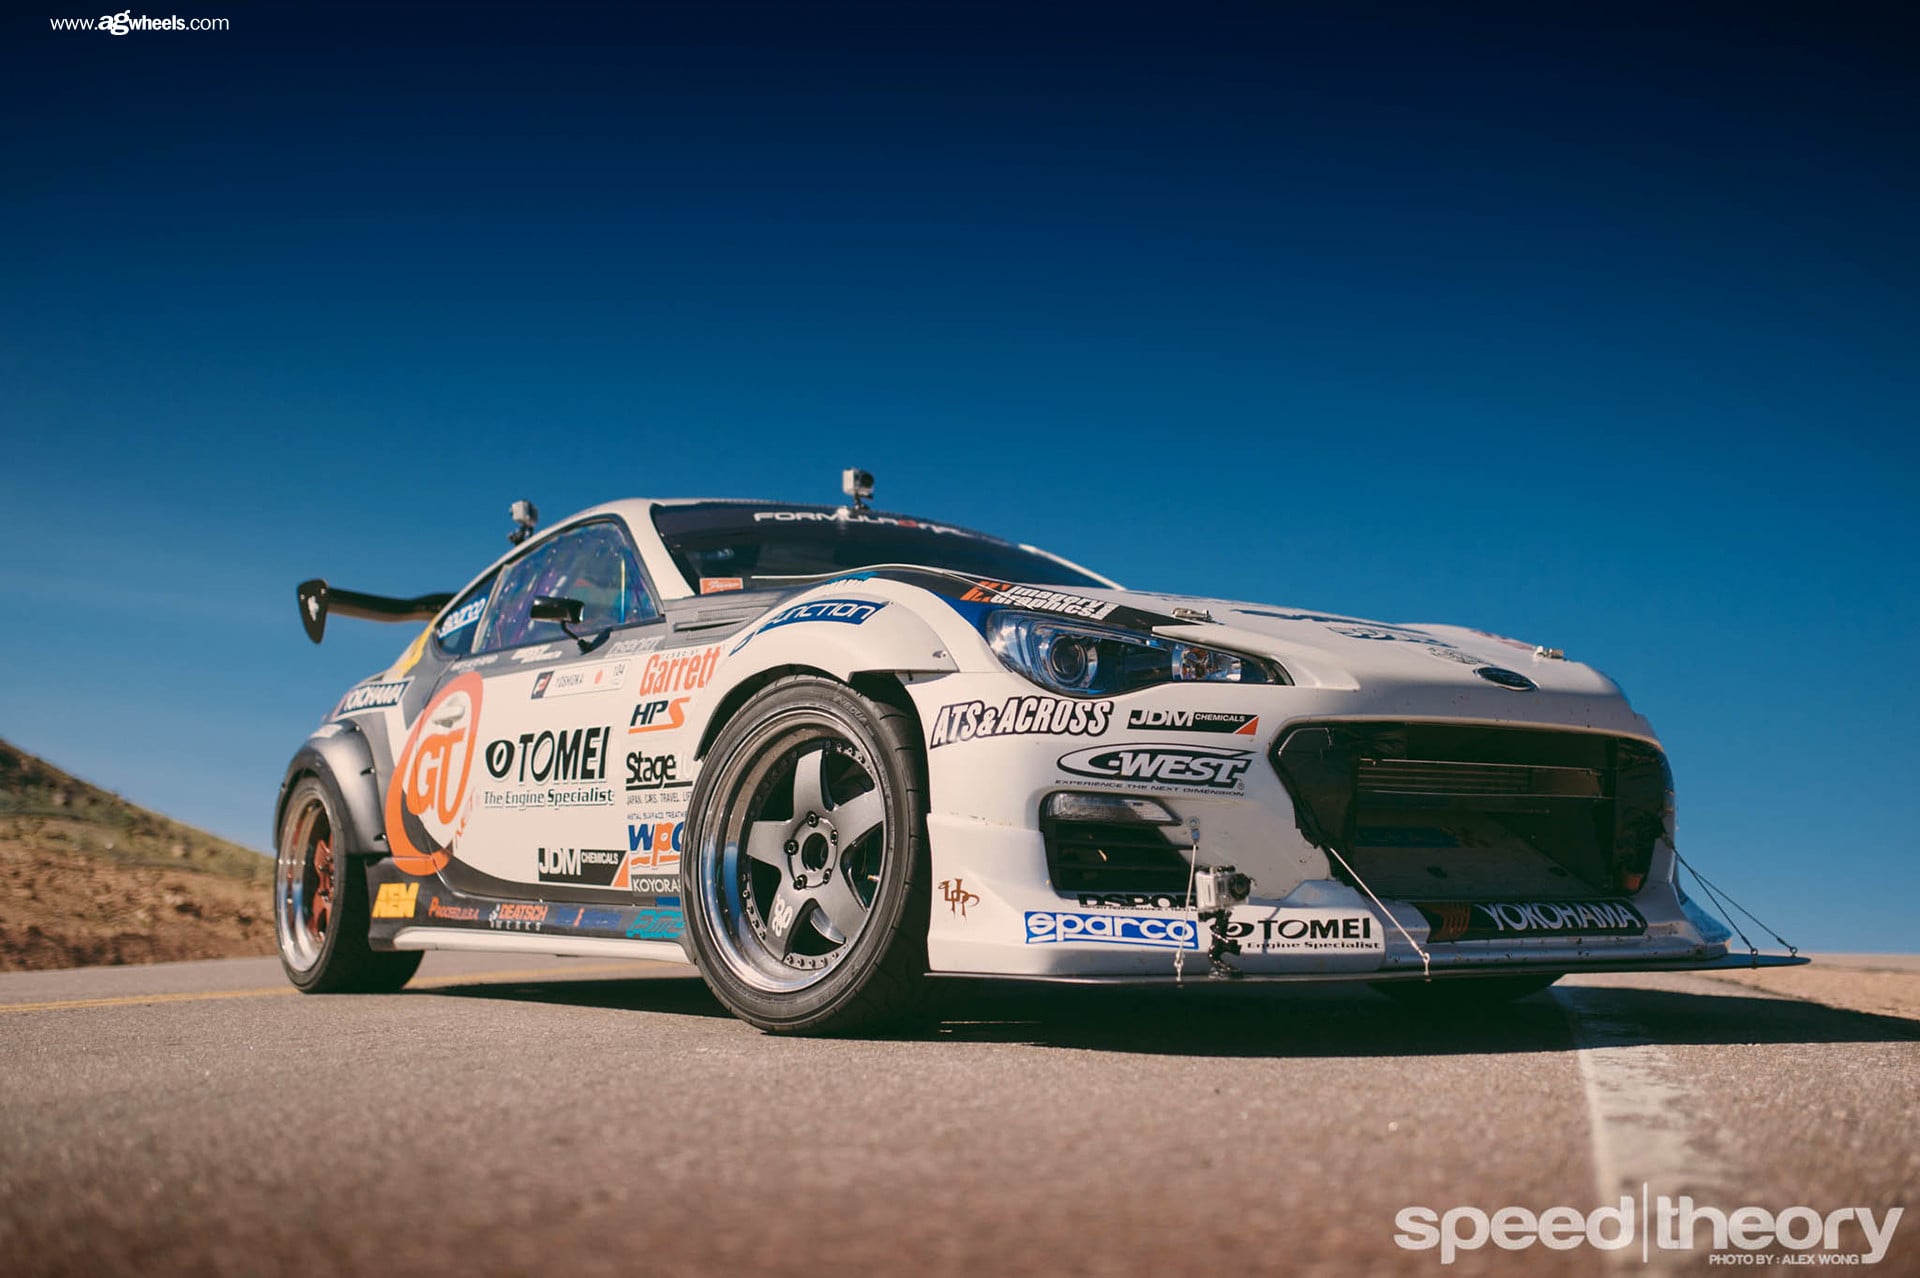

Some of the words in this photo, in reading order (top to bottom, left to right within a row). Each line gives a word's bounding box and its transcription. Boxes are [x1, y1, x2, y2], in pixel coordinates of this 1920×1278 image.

[640, 646, 721, 697] Garrett
[627, 697, 691, 734] HPS
[931, 697, 1114, 748] ATS&ACROSS
[1129, 709, 1195, 727] JDM
[1194, 713, 1246, 722] CHEMICALS
[519, 726, 611, 782] TOMEI
[626, 751, 677, 788] Stage
[484, 790, 503, 805] The
[505, 790, 545, 807] Engine
[547, 786, 615, 806] Specialist
[1055, 779, 1123, 788] EXPERIENCE
[1183, 787, 1244, 797] DIMENSION
[539, 848, 581, 876] JDM
[581, 851, 619, 865] CHEMICALS
[633, 879, 681, 893] KOYORA
[1027, 912, 1195, 942] sparco
[1258, 918, 1371, 939] TOMEI
[1474, 903, 1642, 931] YOKOHAMA
[1304, 941, 1381, 949] Specialist
